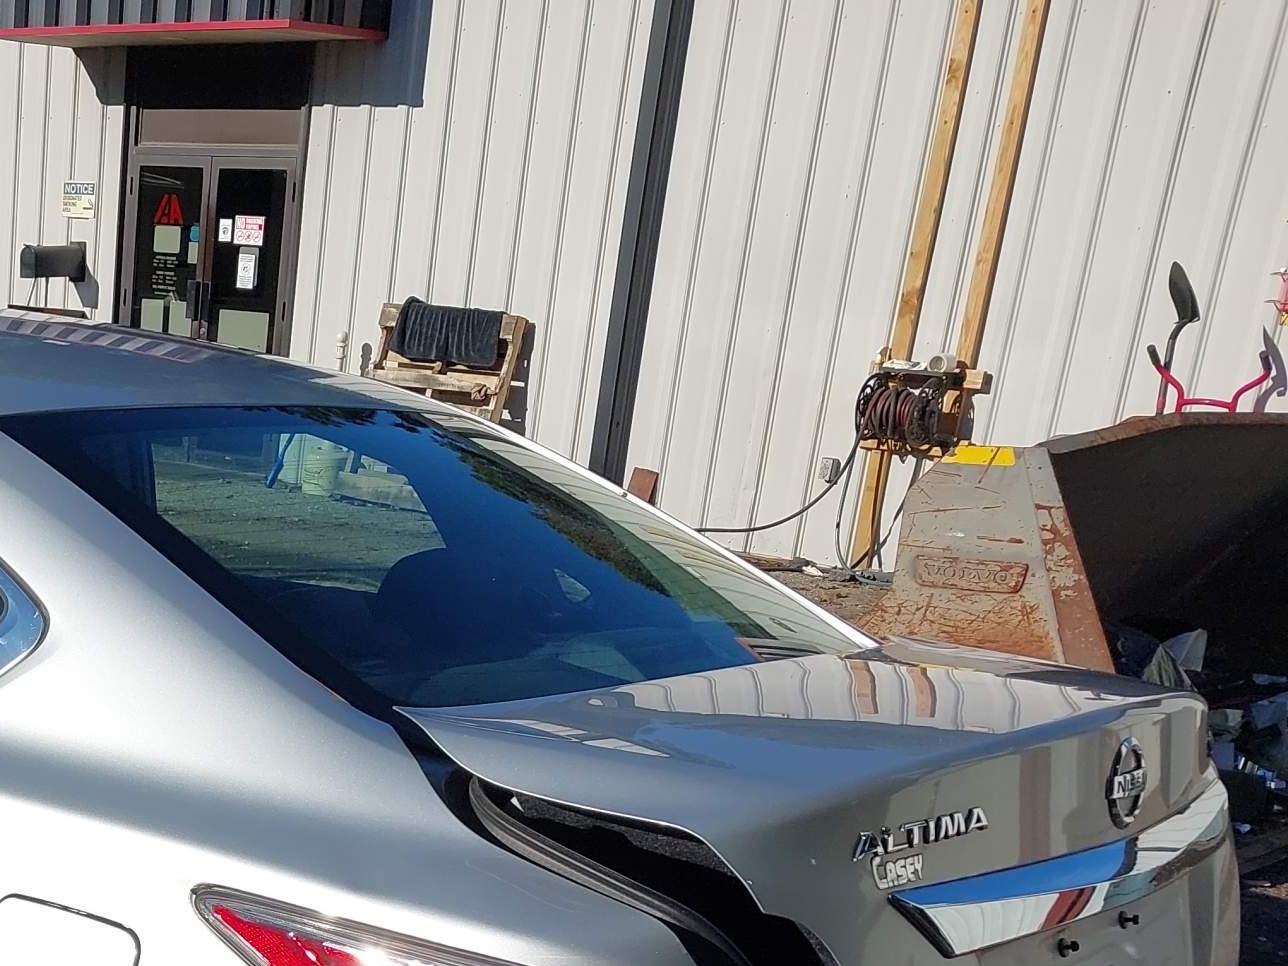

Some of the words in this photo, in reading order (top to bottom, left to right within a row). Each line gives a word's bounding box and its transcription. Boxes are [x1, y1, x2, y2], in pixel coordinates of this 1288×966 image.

[64, 183, 95, 194] NOTICE
[923, 562, 1009, 585] VOLVO
[852, 806, 989, 862] ALTIMA
